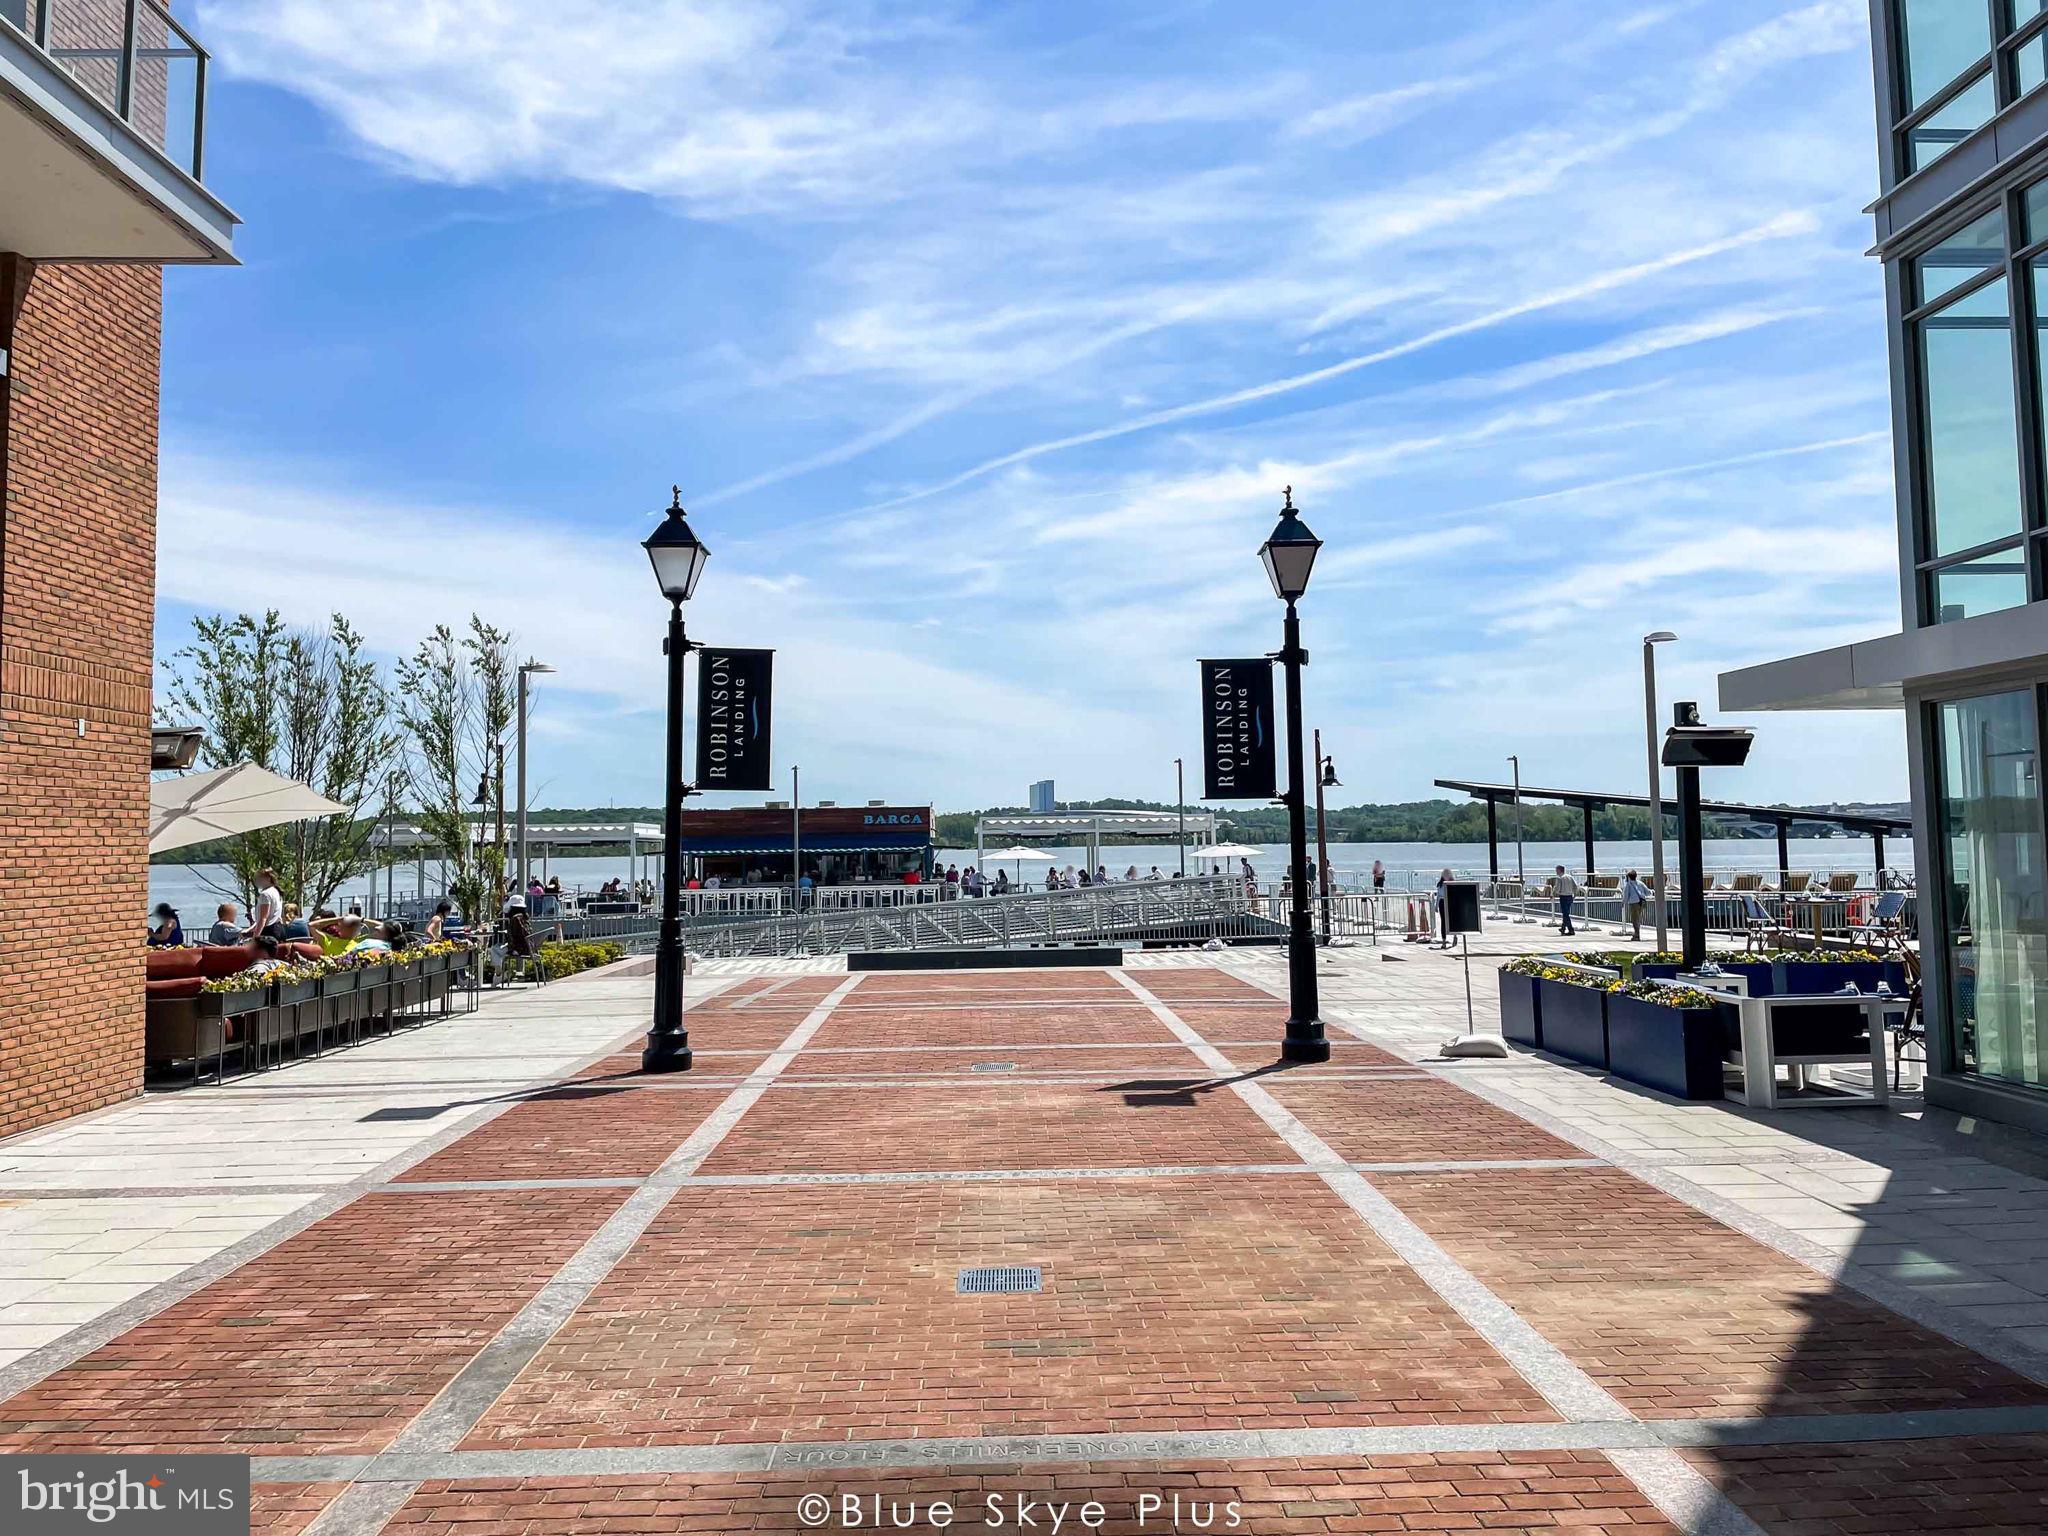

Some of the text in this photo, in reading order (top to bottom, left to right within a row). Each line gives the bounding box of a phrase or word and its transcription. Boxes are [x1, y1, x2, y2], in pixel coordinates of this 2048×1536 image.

[709, 656, 730, 778] ROBINSON
[734, 678, 746, 757] LANDING
[1214, 667, 1235, 787] ROBINSON
[1238, 688, 1250, 766] LANDING
[863, 814, 923, 825] BARCA
[784, 1449, 889, 1462] FLOUR
[922, 1445, 1009, 1458] MILLS
